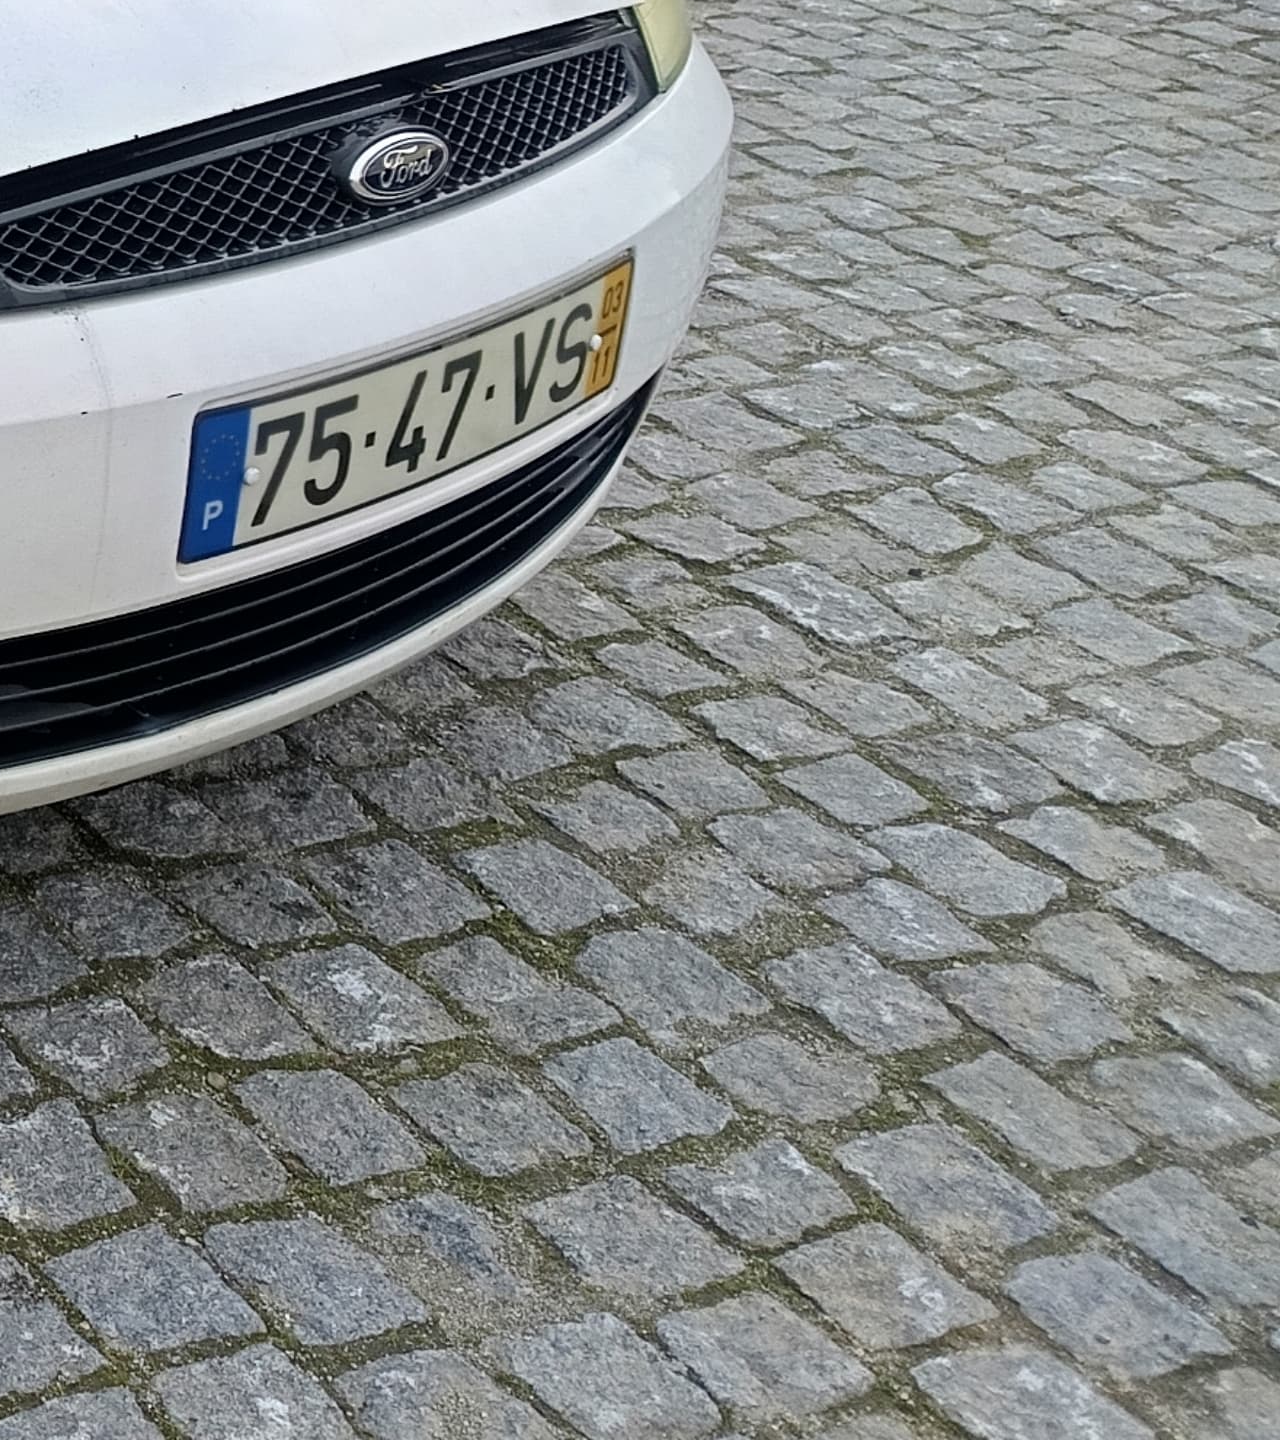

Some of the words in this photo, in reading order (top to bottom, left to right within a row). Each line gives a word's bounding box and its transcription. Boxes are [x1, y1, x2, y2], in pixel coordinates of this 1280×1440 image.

[380, 145, 433, 189] Ford
[601, 278, 624, 318] 03
[202, 499, 224, 531] P
